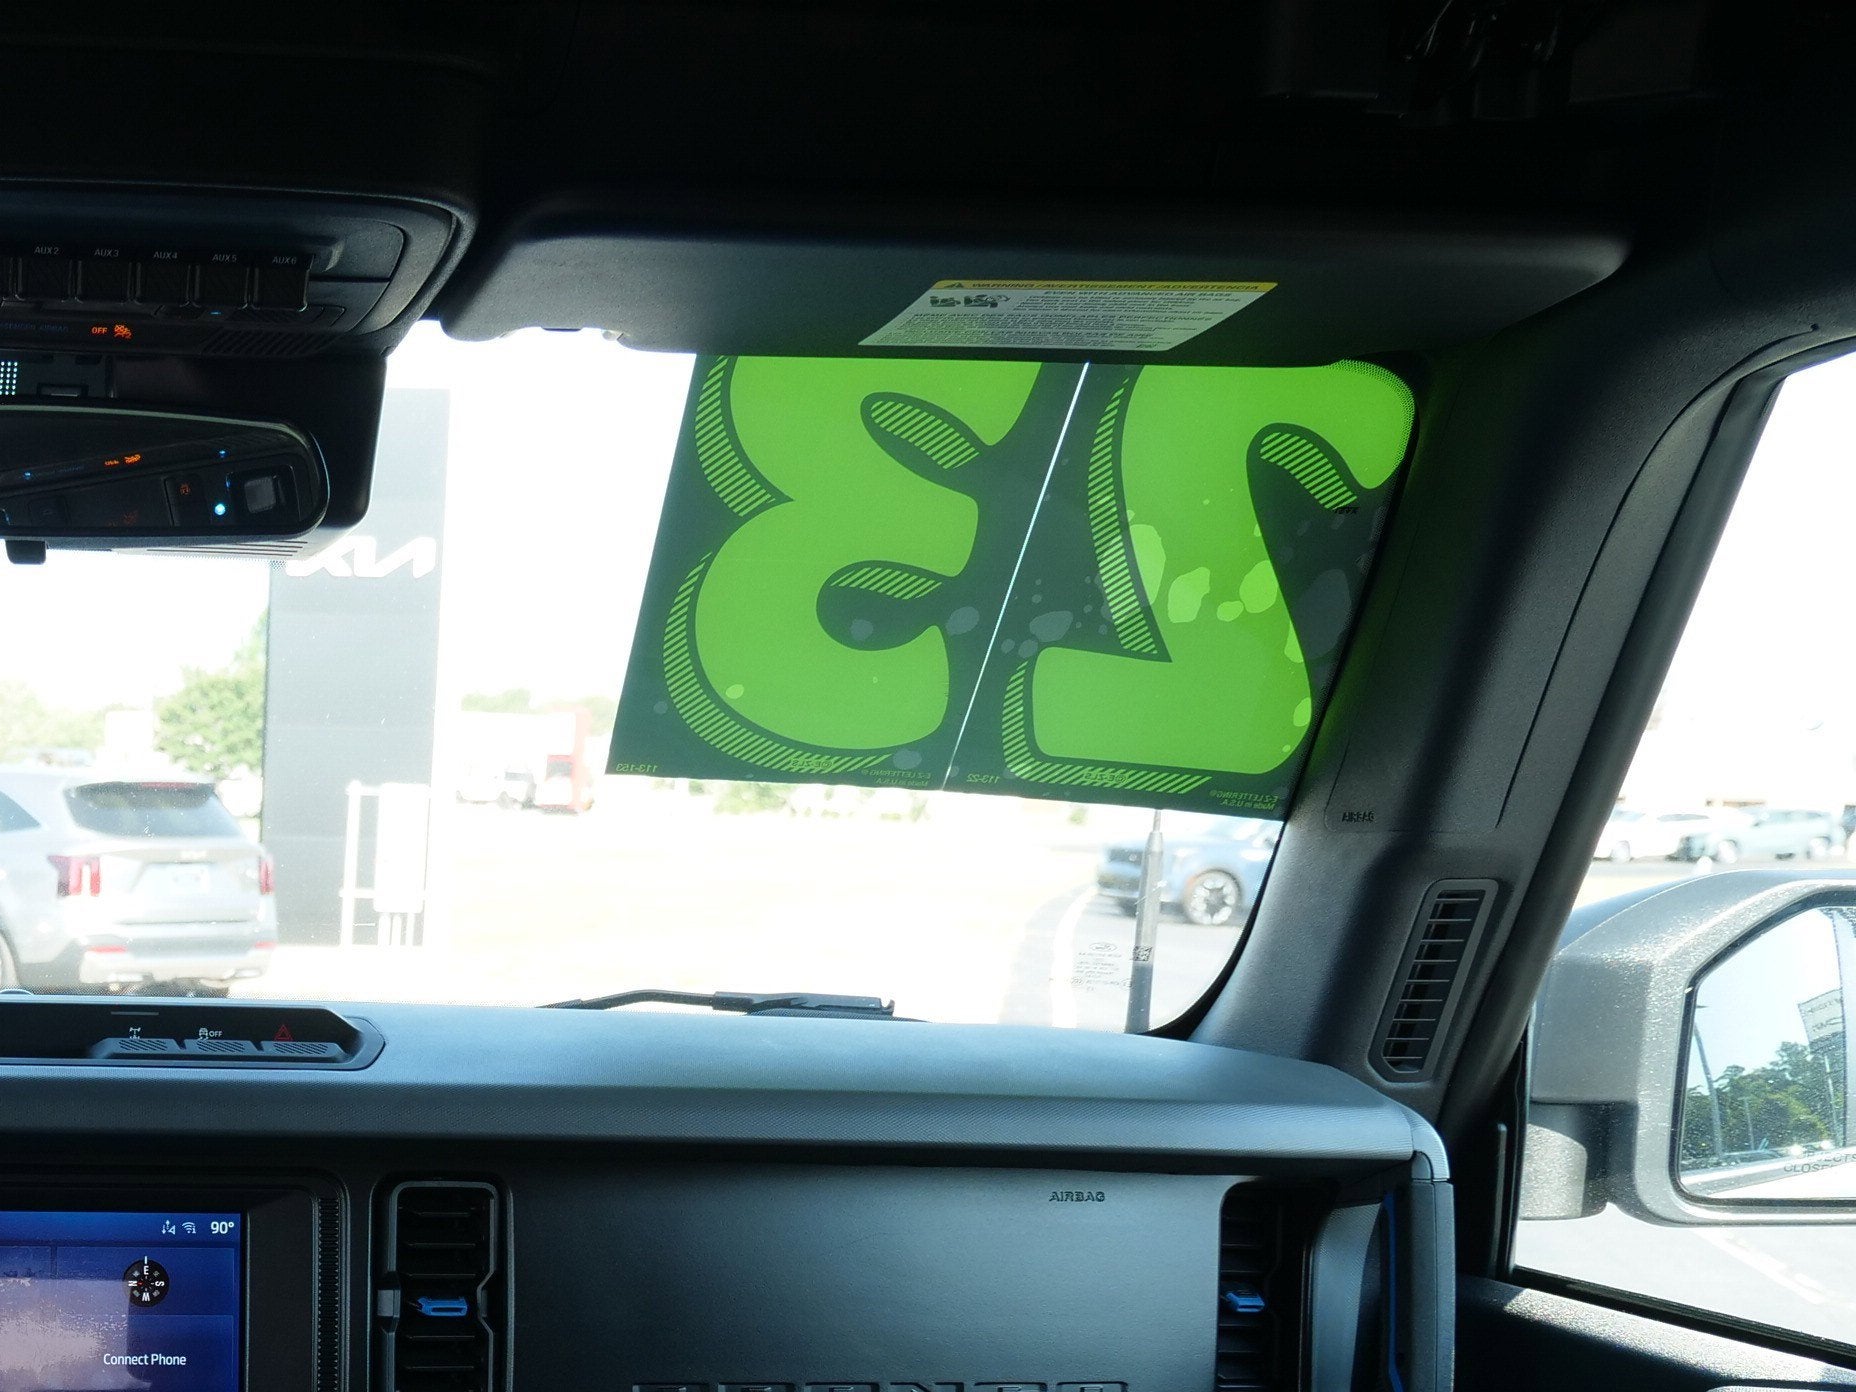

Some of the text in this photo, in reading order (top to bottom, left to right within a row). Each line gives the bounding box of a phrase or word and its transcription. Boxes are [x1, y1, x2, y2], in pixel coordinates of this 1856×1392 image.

[90, 326, 108, 334] OFF
[208, 1030, 223, 1038] OFF
[1048, 1191, 1106, 1203] AIRBAG
[210, 1221, 235, 1234] 90°
[103, 1353, 187, 1365] Connect Phone
